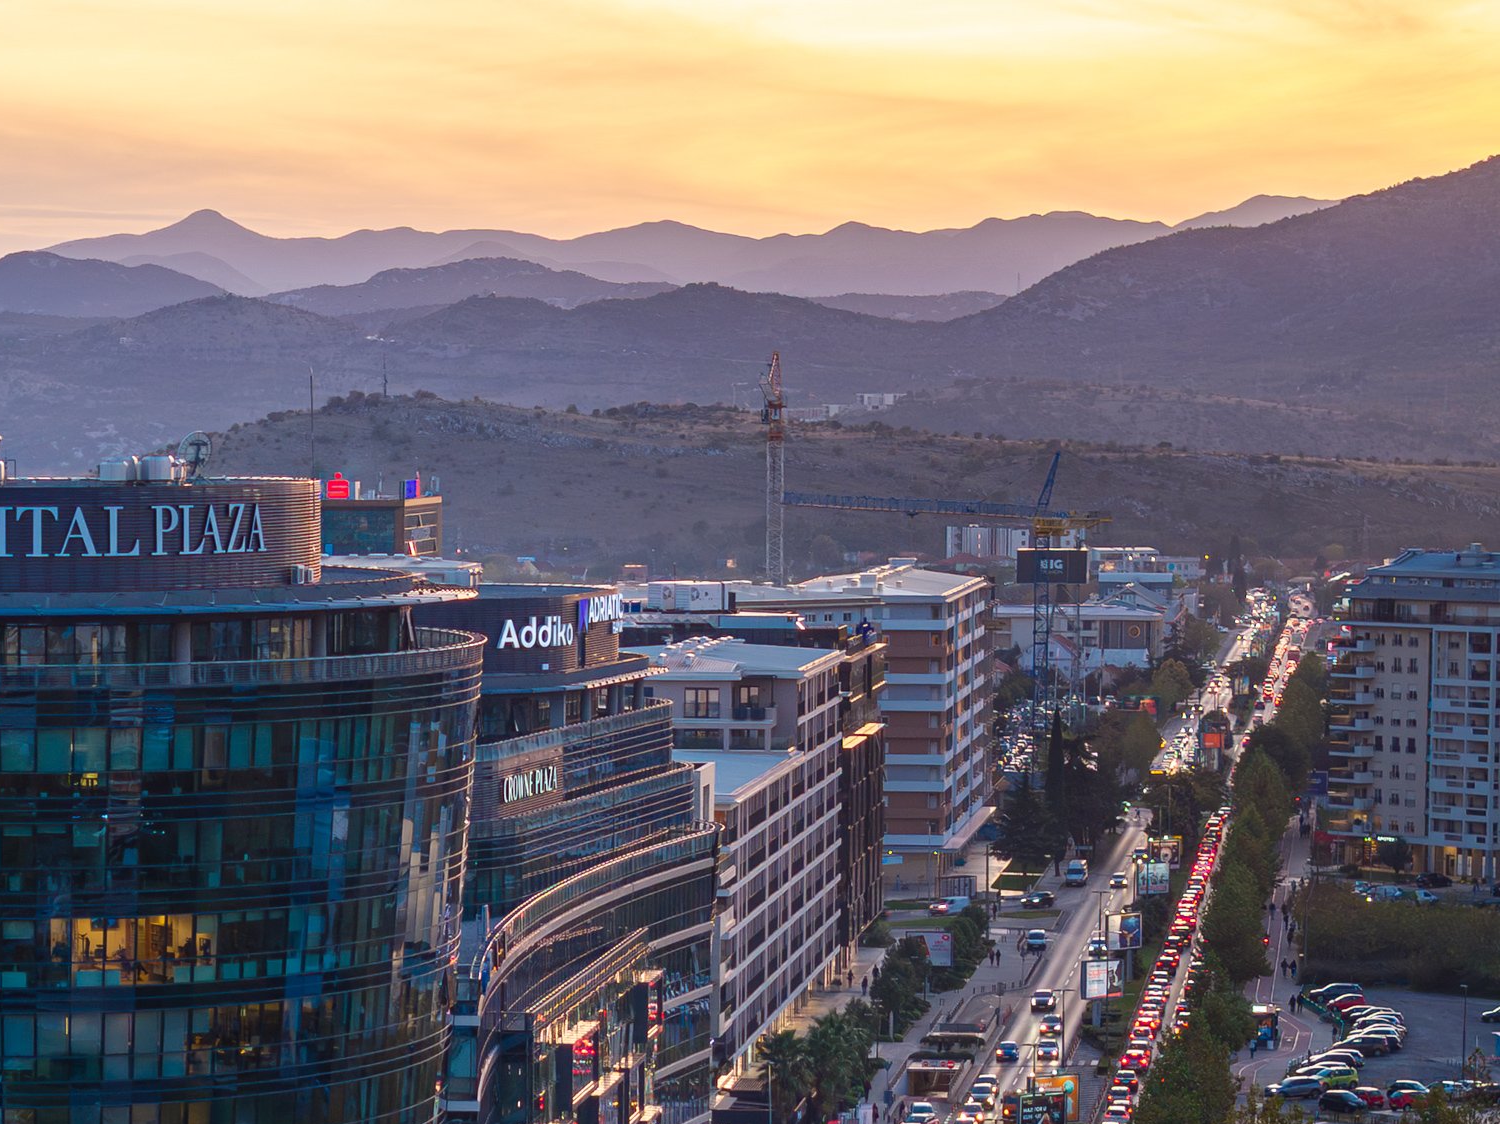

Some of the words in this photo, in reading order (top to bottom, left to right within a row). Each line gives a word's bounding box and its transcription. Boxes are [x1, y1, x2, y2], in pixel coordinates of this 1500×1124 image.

[150, 503, 268, 557] PLAZA
[588, 593, 624, 623] ADRIATIC
[497, 615, 574, 649] Addiko
[503, 771, 534, 804] CROWNE
[535, 765, 558, 794] PLAZA
